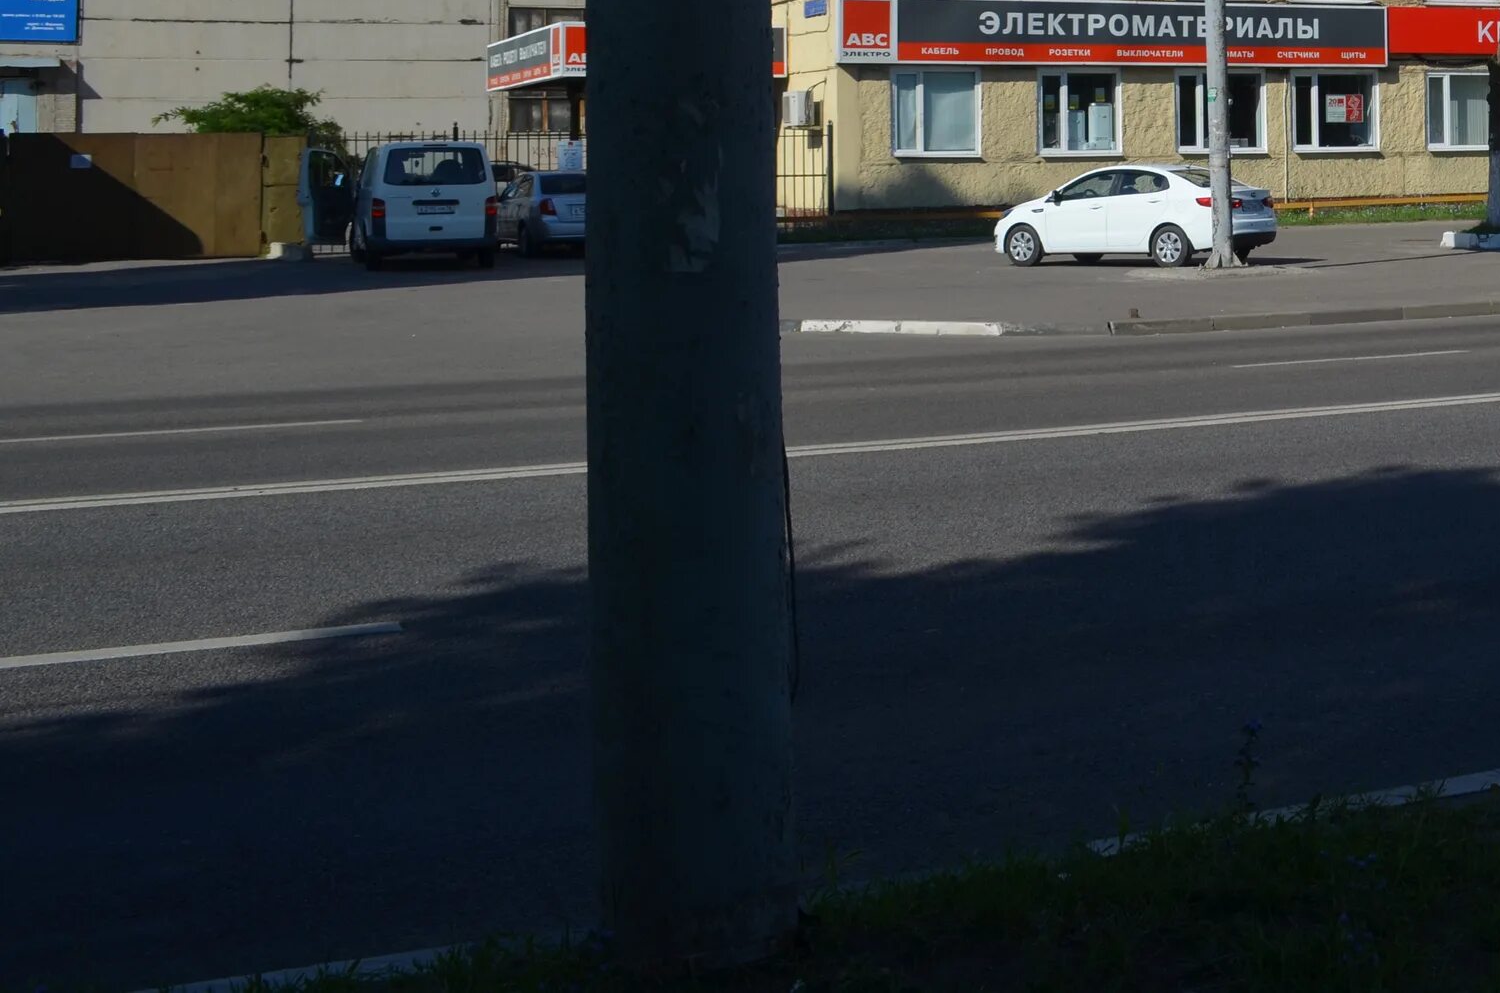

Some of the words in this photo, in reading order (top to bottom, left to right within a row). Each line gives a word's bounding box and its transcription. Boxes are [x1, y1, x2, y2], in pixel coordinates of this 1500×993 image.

[846, 32, 888, 46] АВС
[921, 47, 960, 55] КАБЕЛЬ
[985, 48, 1025, 57] ПРОВОД
[1048, 48, 1091, 57] РОЗЕТКИ
[1116, 49, 1184, 57] ВЫКЛЮЧАТЕЛИ
[1277, 51, 1320, 59] СЧЕТЧИКИ
[1340, 51, 1367, 60] ЩИТЫ
